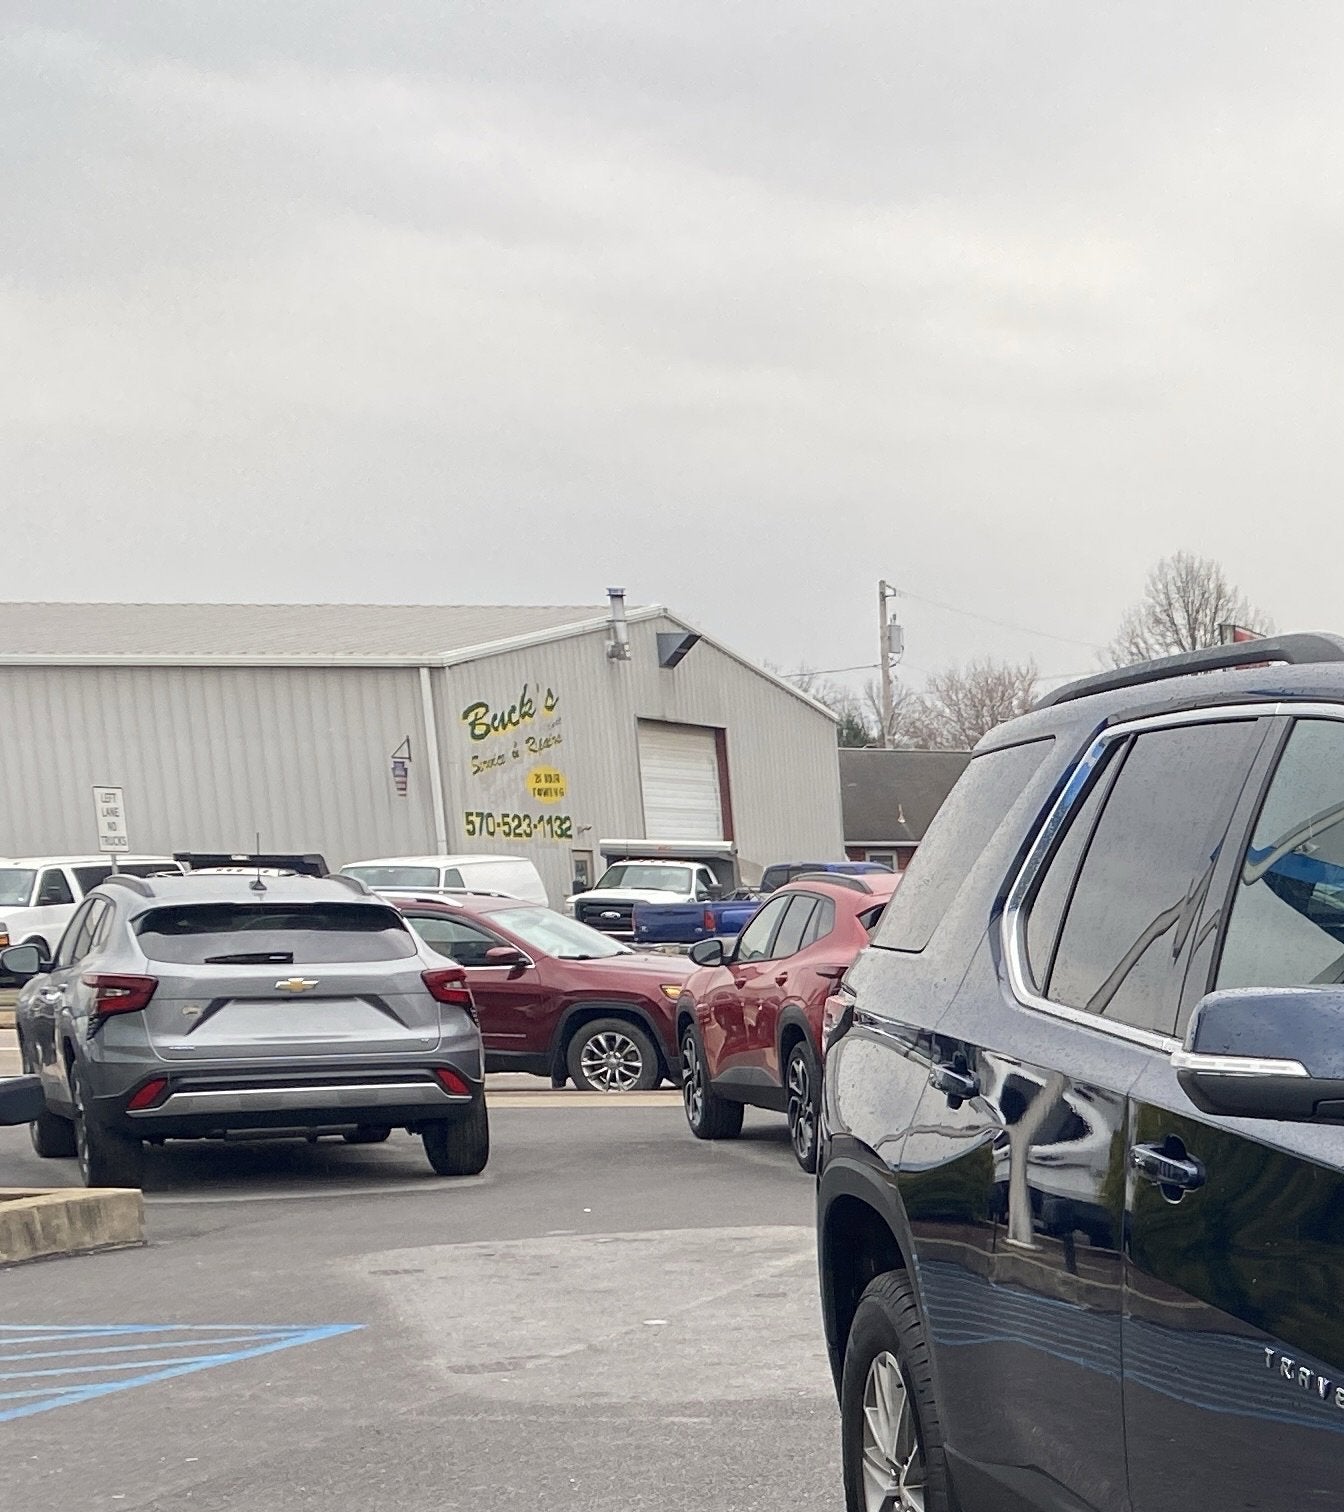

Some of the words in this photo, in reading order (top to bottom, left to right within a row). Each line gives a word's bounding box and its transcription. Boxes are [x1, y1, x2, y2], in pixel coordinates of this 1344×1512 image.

[462, 683, 559, 740] Buck's
[101, 792, 116, 804] LEFT
[532, 787, 564, 798] TOWING
[101, 807, 120, 818] LANE
[106, 821, 117, 832] NO
[465, 811, 573, 839] 570-523-1132
